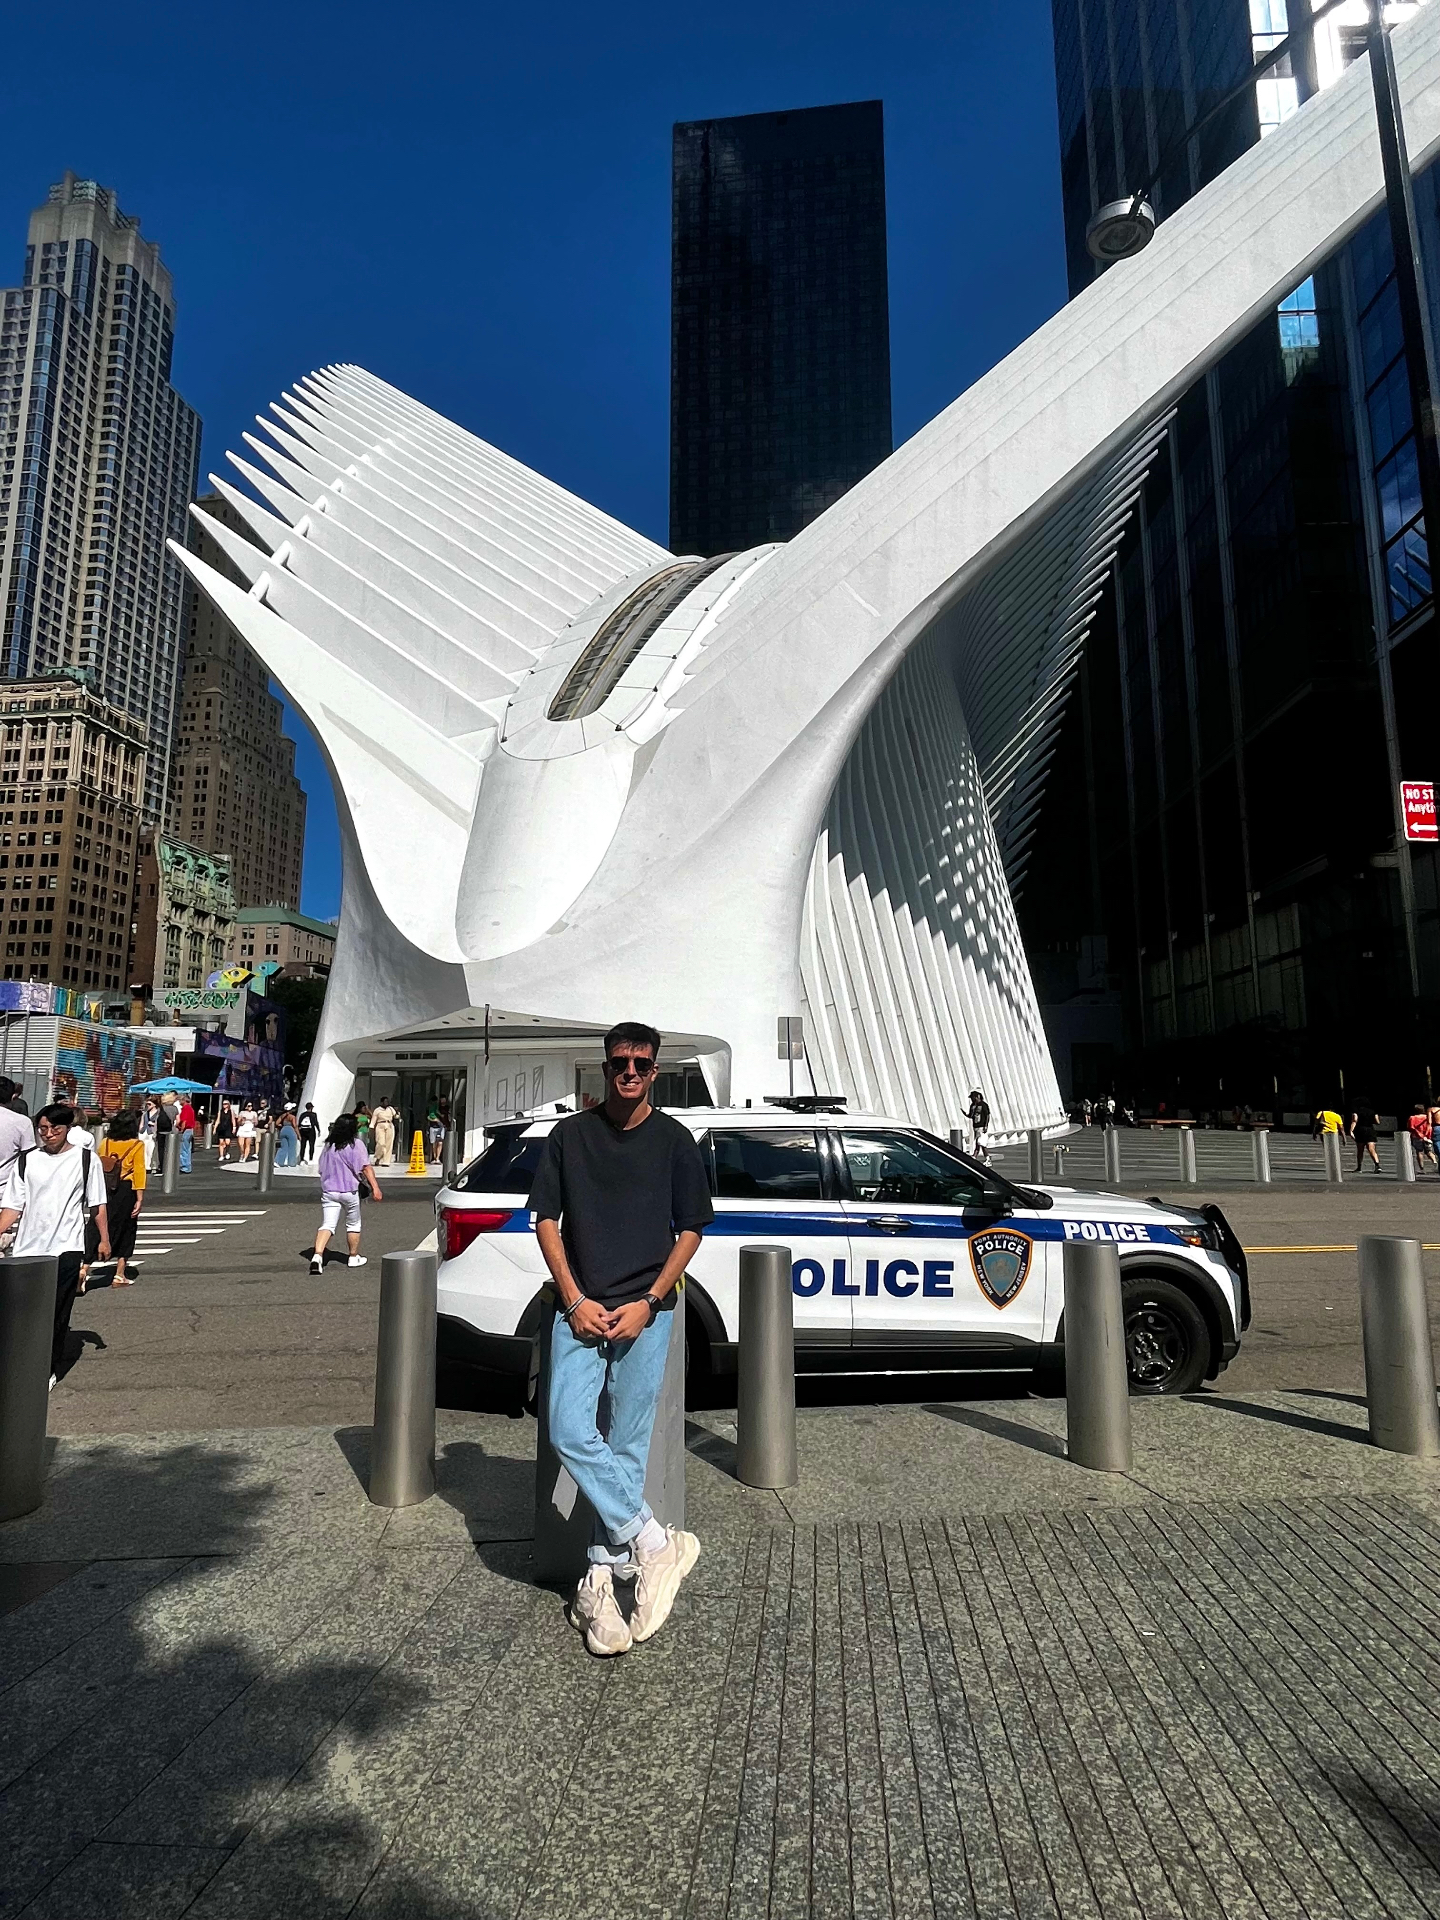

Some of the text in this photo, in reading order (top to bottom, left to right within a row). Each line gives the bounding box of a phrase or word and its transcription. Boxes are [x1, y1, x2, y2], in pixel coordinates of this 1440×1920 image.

[1405, 788, 1420, 800] NO
[974, 1234, 1028, 1246] PORT AUTHORITY
[1062, 1221, 1151, 1241] POLICE
[976, 1240, 1025, 1256] POLICE
[791, 1258, 954, 1298] OLICE
[976, 1264, 995, 1296] NEW YORK
[1005, 1262, 1027, 1299] NEW JERSEY
